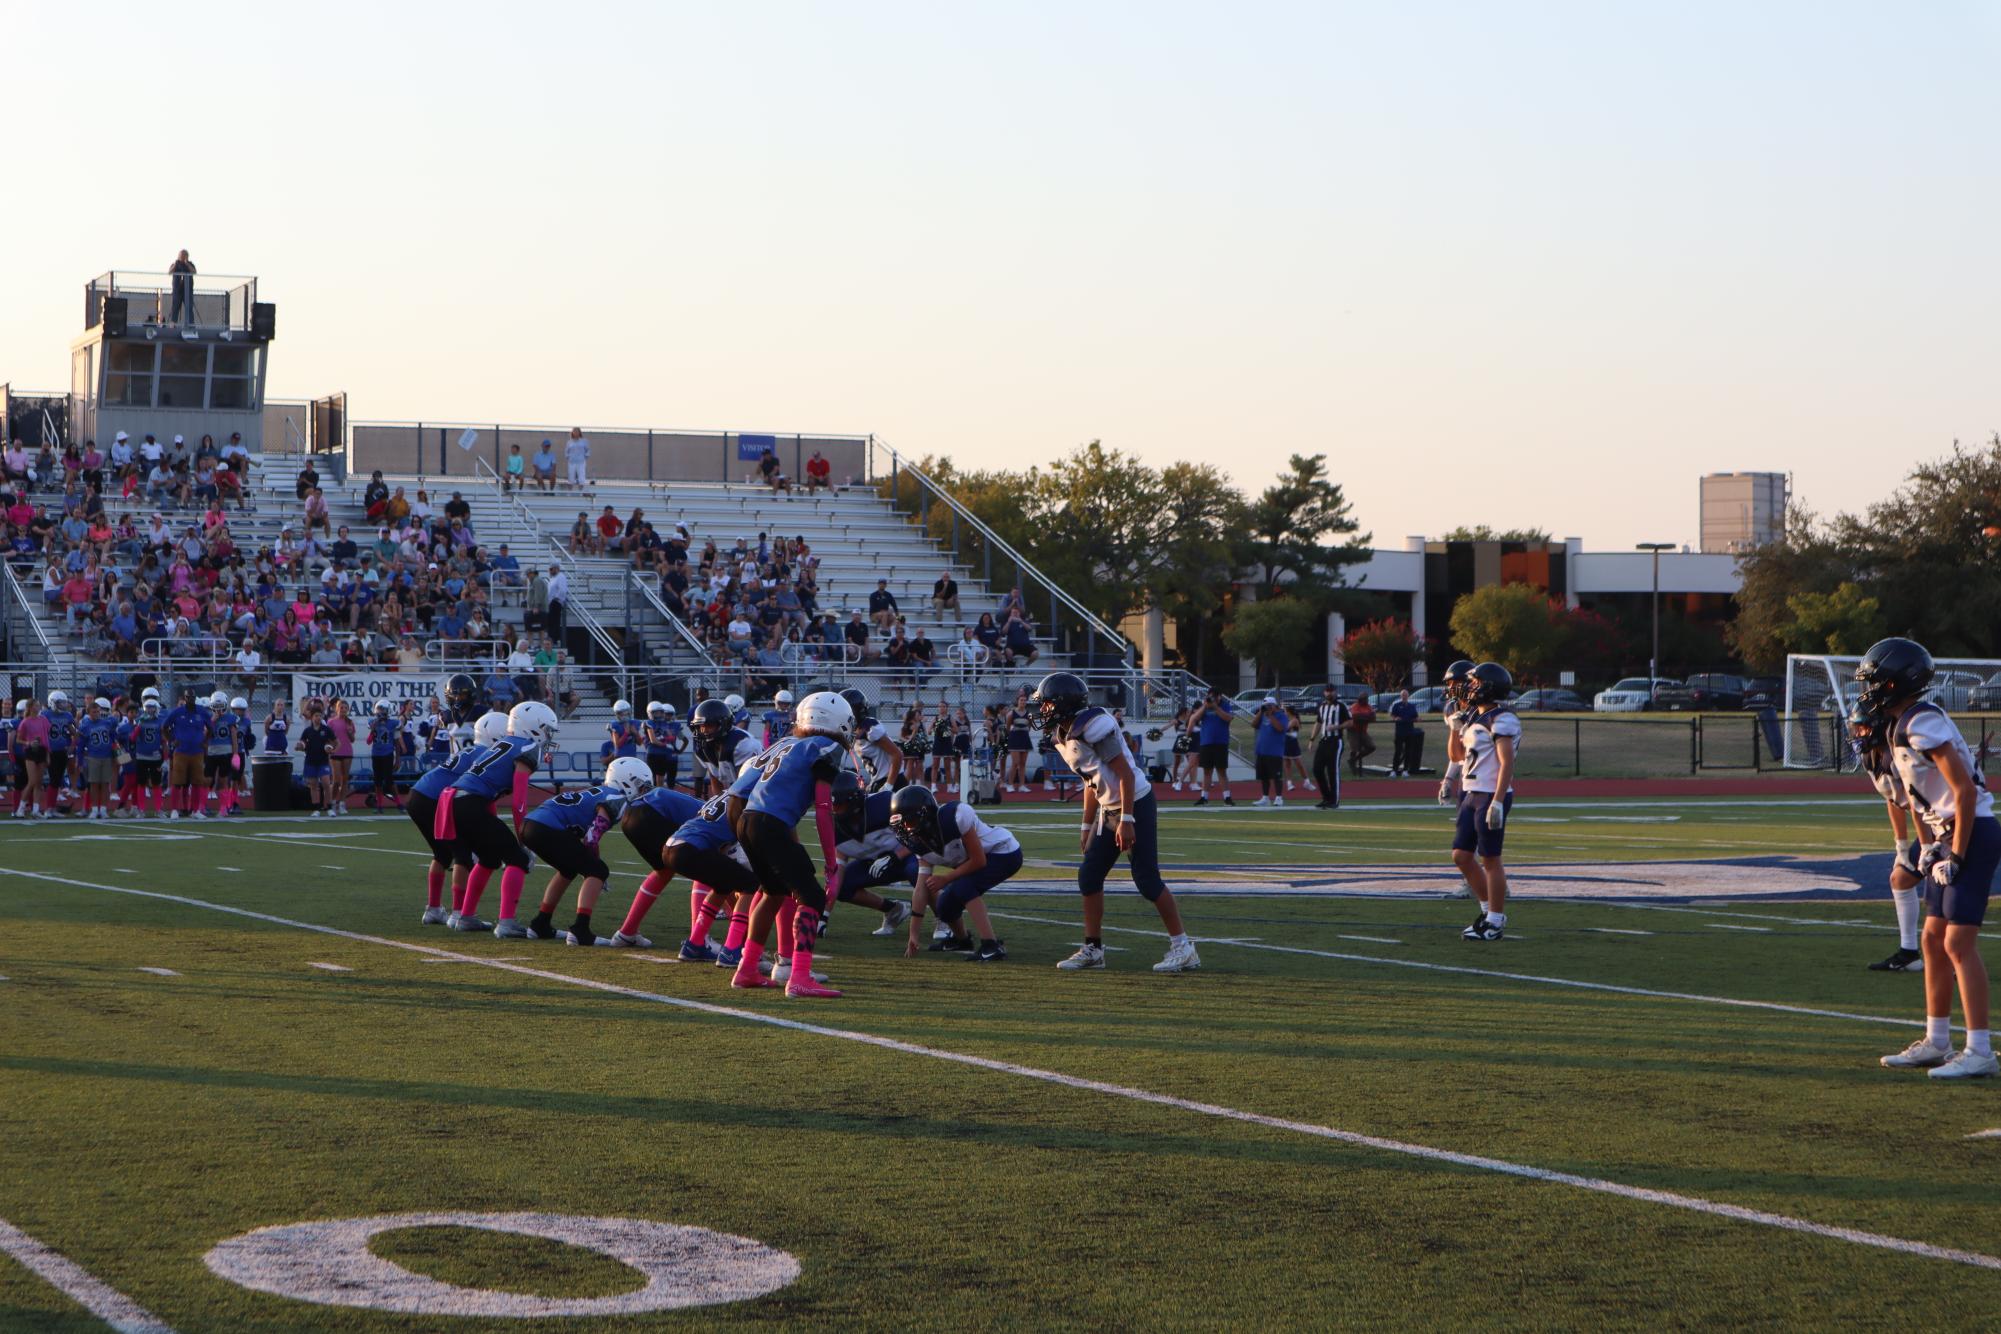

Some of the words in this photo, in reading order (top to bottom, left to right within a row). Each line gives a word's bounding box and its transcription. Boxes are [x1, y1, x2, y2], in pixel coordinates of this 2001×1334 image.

[306, 681, 364, 698] HOME
[369, 681, 393, 698] OF
[396, 681, 437, 698] THE
[203, 1211, 802, 1317] 0
